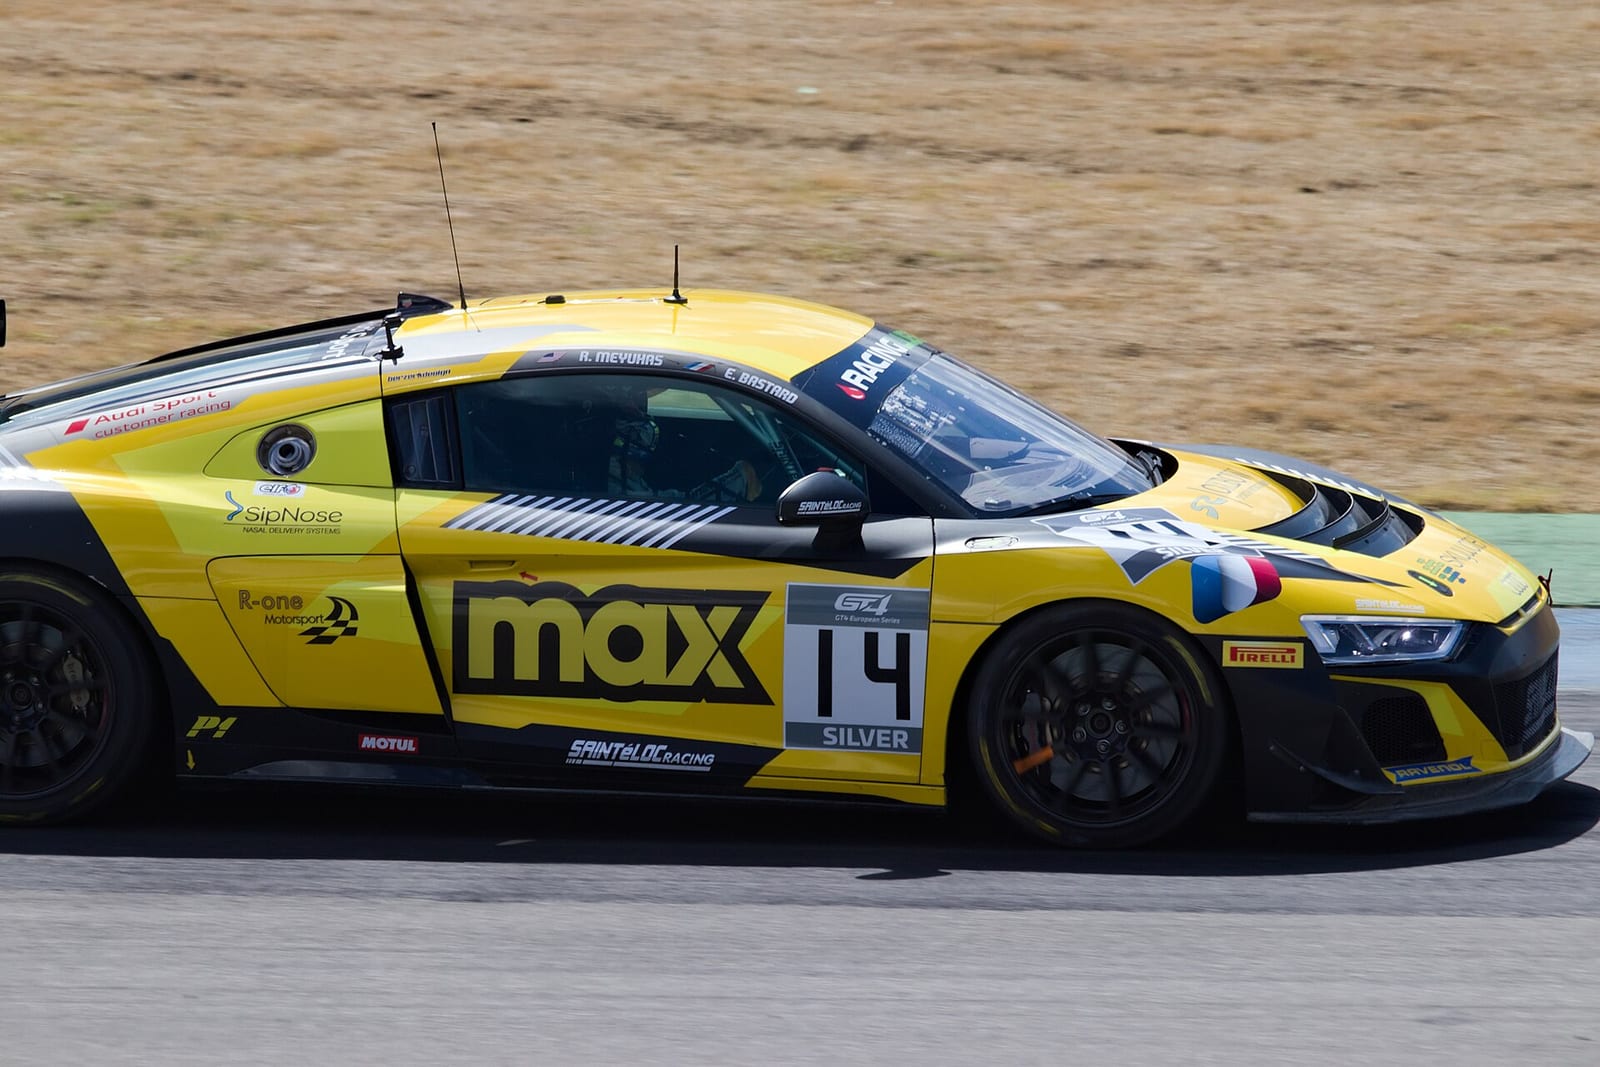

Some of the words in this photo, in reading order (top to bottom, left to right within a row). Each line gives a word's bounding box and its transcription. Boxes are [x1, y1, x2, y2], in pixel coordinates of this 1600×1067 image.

[578, 351, 592, 362] R.
[595, 352, 664, 366] MEYUHAS
[840, 337, 909, 391] RACING
[724, 368, 736, 381] E.
[738, 372, 799, 405] BASTARD
[94, 406, 146, 426] Audi
[153, 391, 217, 411] Sport
[95, 413, 175, 438] customer
[180, 400, 232, 419] racing
[245, 506, 343, 525] SipNose
[243, 526, 267, 534] NASAL
[269, 526, 304, 535] DELIVERY
[306, 527, 341, 535] SYSTEMS
[238, 590, 303, 611] R-one
[834, 593, 893, 616] GT4
[264, 613, 325, 626] Motorsport
[850, 615, 880, 624] European
[881, 616, 900, 625] Series
[468, 597, 745, 688] max
[1230, 646, 1297, 663] PIRELLI
[817, 629, 911, 720] 14
[361, 736, 416, 751] MOTUL
[823, 727, 909, 749] SILVER
[1395, 763, 1472, 777] RAVENOL
